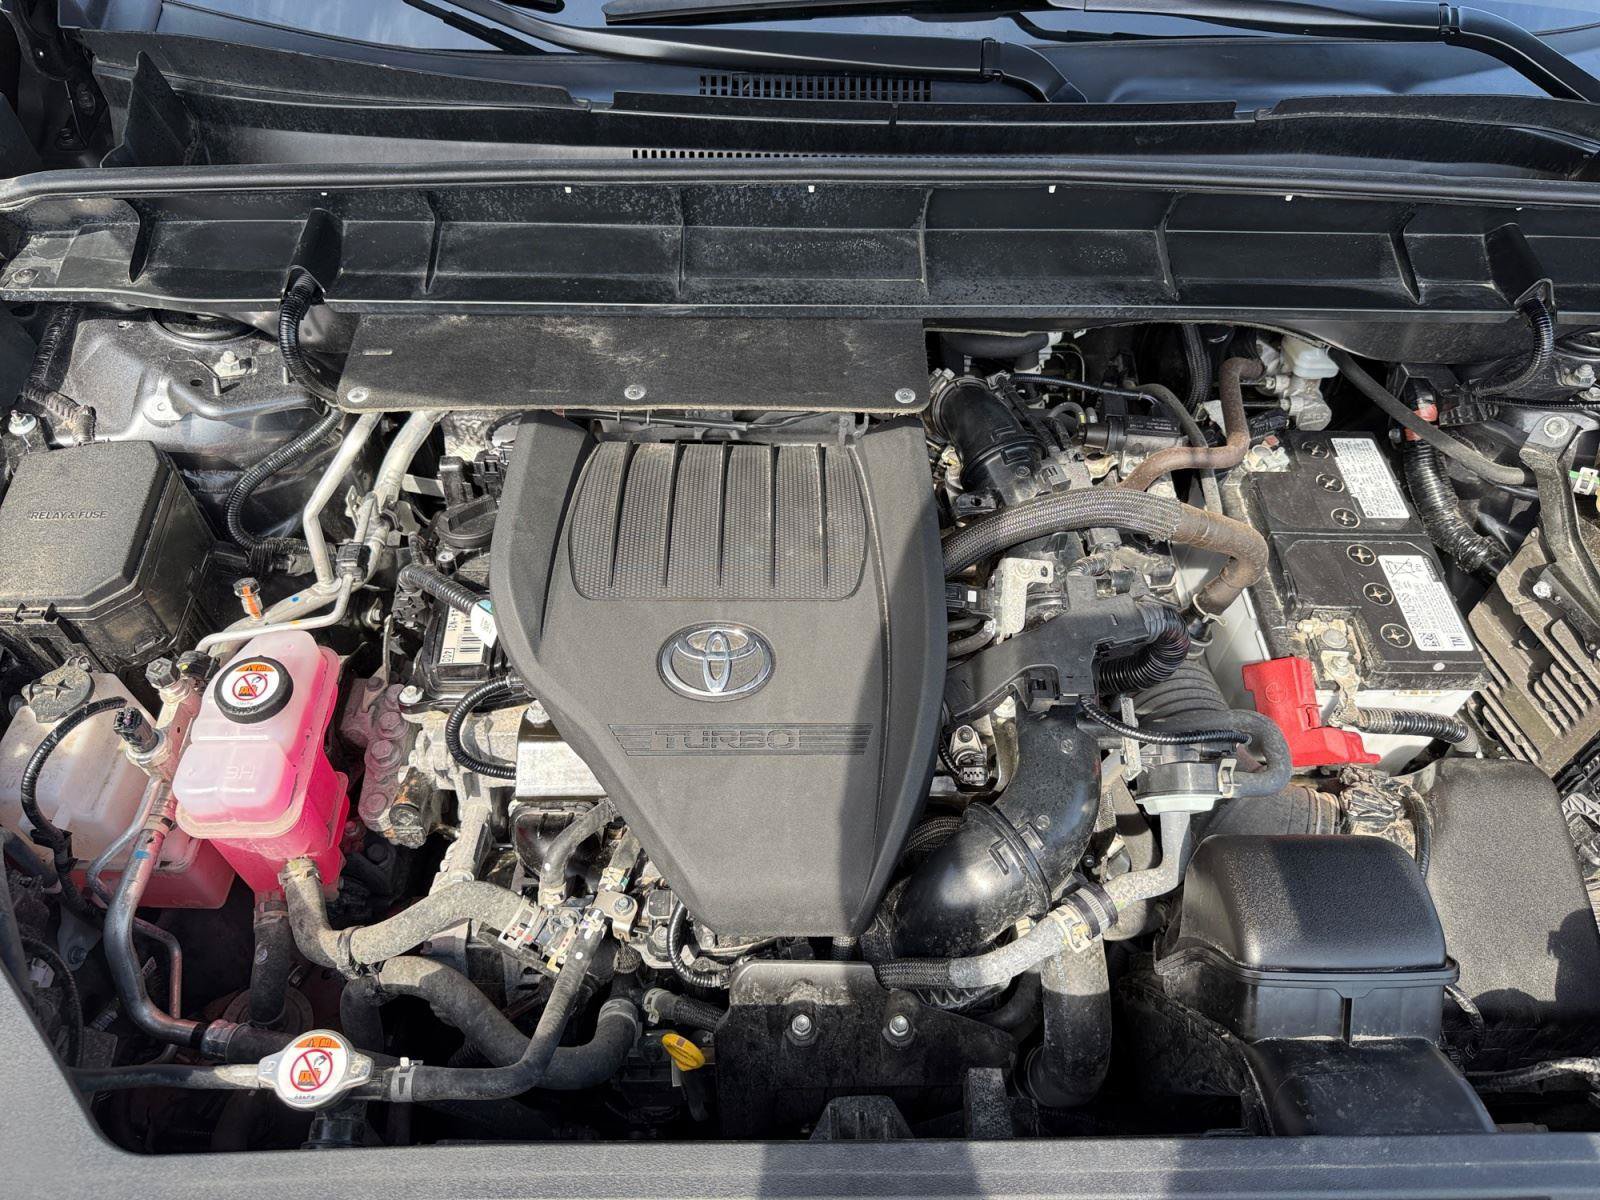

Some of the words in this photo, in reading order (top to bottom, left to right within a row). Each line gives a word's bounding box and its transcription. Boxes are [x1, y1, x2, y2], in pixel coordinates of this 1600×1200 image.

[30, 510, 67, 520] RELAY
[67, 510, 76, 519] &
[78, 510, 107, 519] FUSE
[654, 729, 795, 749] TURBO
